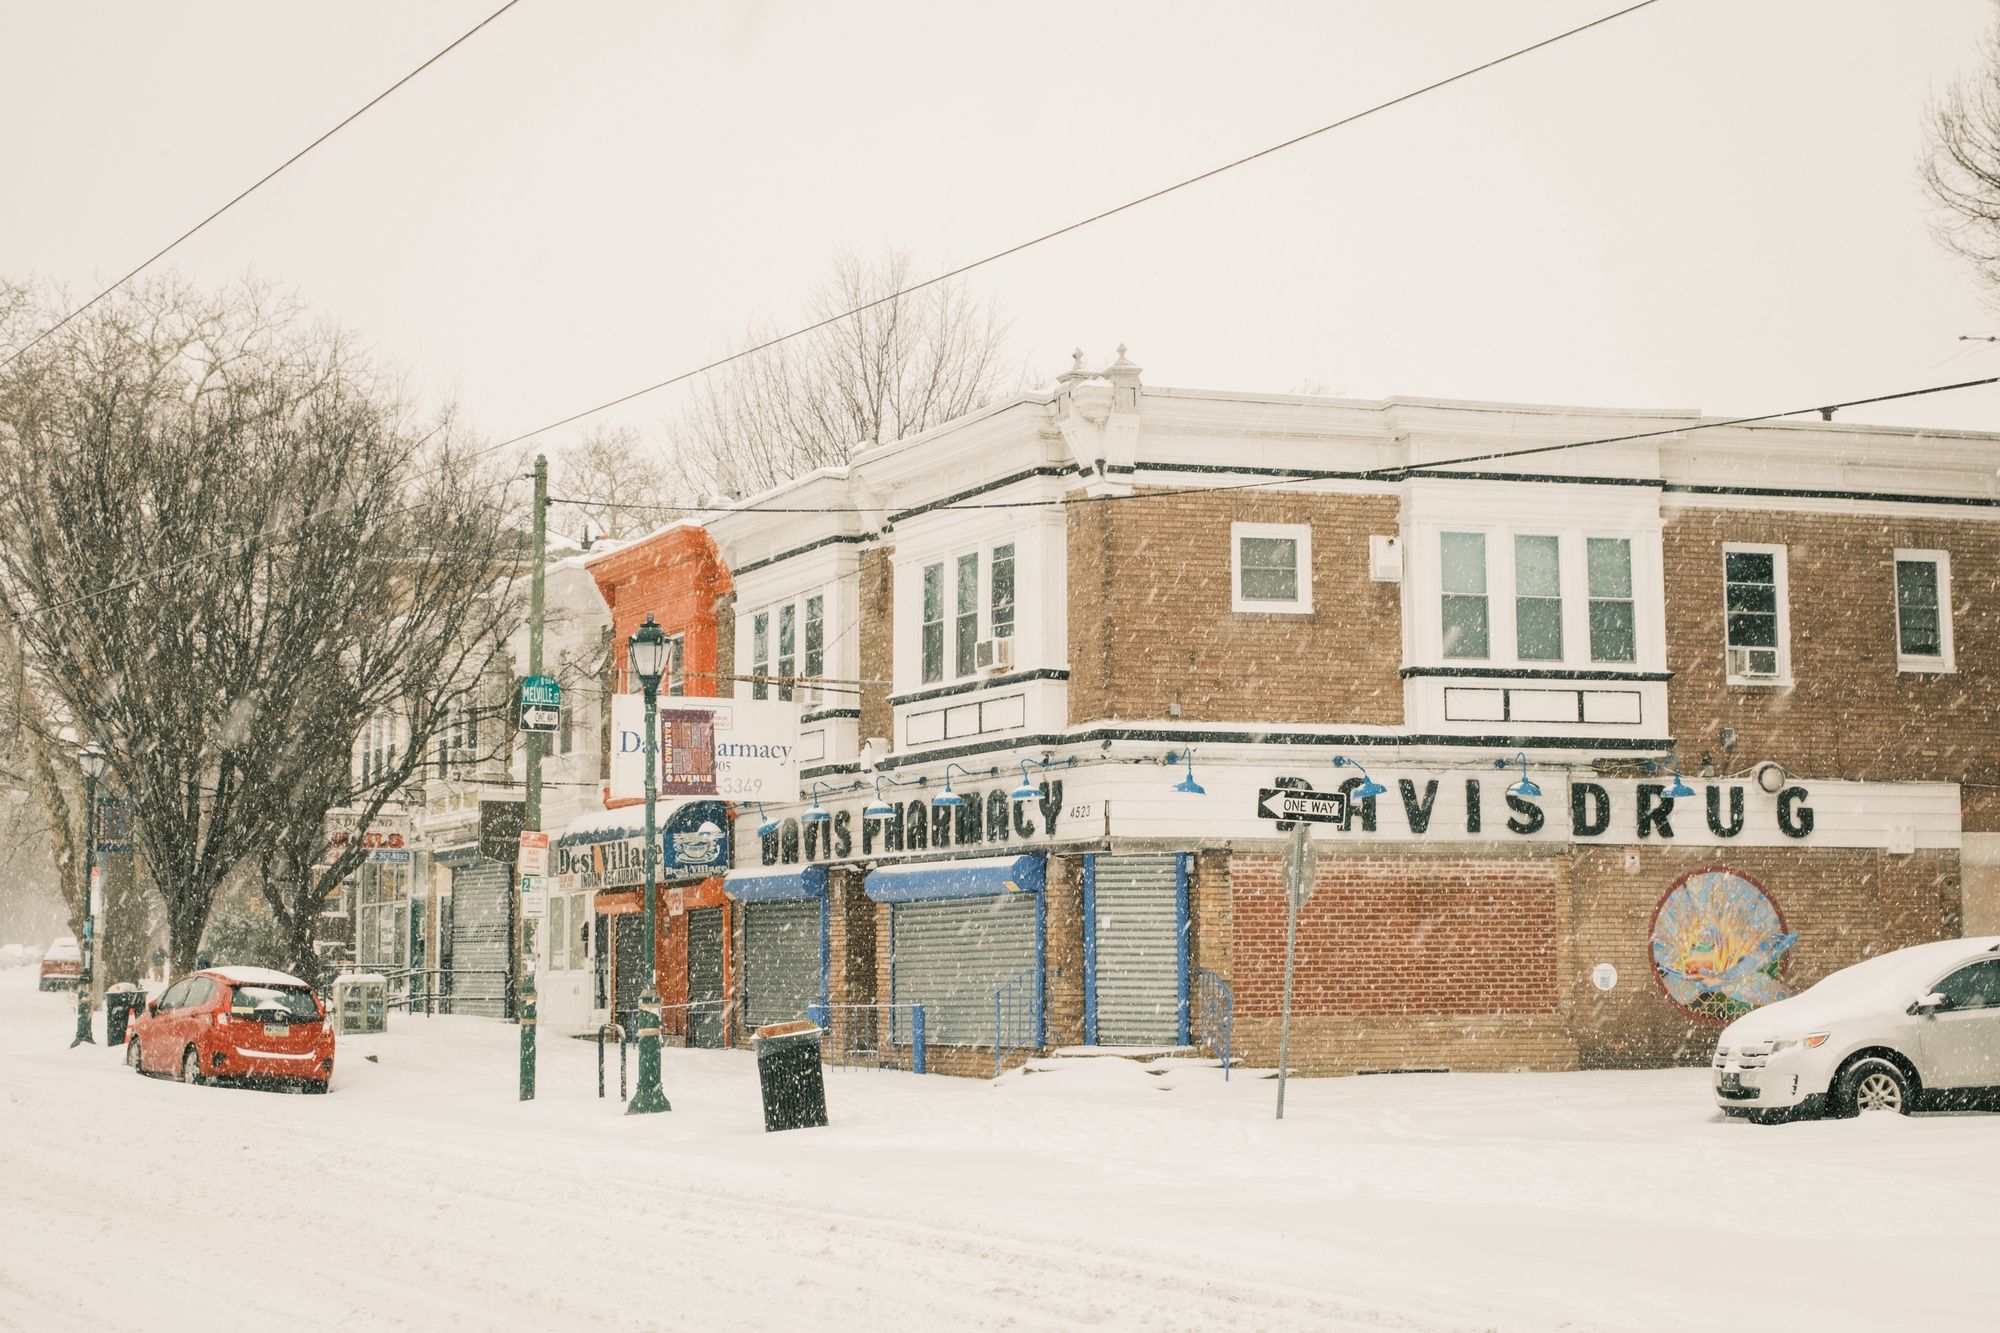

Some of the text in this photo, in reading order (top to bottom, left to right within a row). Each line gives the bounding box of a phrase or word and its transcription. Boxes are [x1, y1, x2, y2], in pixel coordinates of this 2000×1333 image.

[522, 686, 553, 703] MELVILLE
[534, 712, 557, 723] ONE WAY
[664, 721, 673, 774] BALTIMORE
[673, 774, 712, 783] AVENUE
[1070, 805, 1092, 818] 4523
[1283, 799, 1336, 814] ONE WAY
[1571, 782, 1815, 839] DRUG
[486, 814, 514, 832] SPRUCE
[761, 779, 1064, 866] DAVIS PHARMACY
[528, 849, 540, 857] ANY
[558, 846, 595, 875] Desi
[523, 879, 530, 890] 2
[580, 871, 602, 889] INDIAN
[603, 867, 642, 885] RESTAURANT
